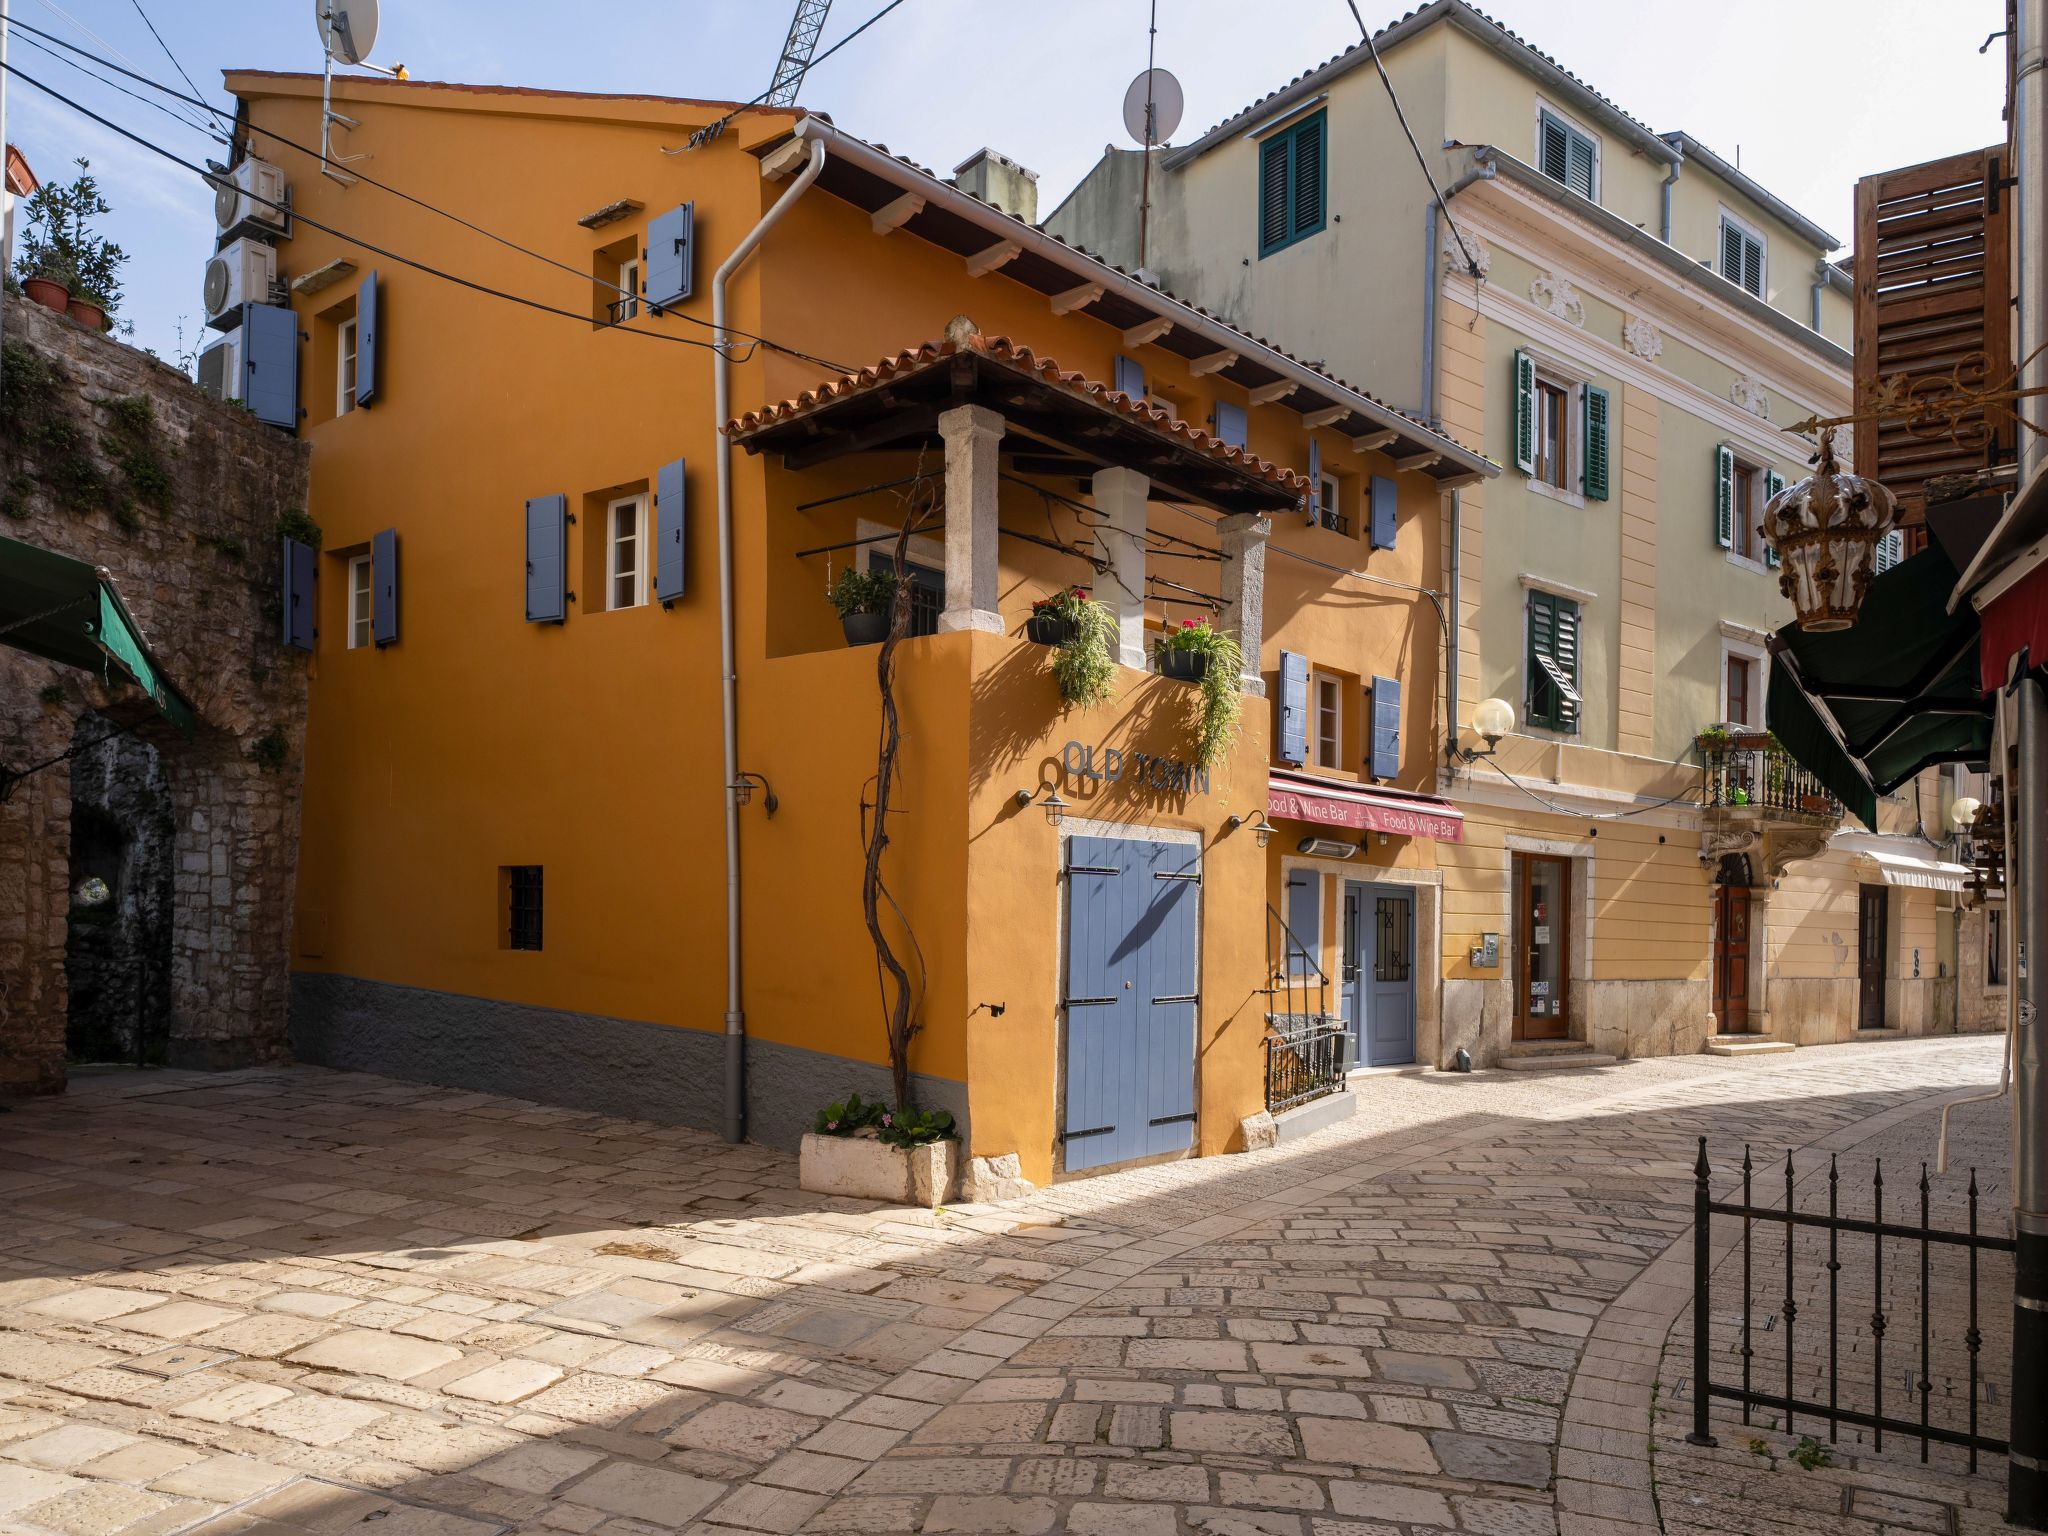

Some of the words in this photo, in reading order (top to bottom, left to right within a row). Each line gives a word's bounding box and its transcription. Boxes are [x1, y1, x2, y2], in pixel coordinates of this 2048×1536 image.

[1063, 739, 1123, 782] OLD
[1134, 751, 1210, 796] TOWN
[1268, 796, 1287, 813] ood
[1290, 798, 1299, 814] &
[1300, 800, 1328, 819] Wine
[1330, 804, 1348, 821] Bar
[1383, 812, 1407, 830] Food
[1408, 816, 1416, 831] &
[1417, 818, 1439, 834] Wine
[1440, 821, 1455, 836] Bar
